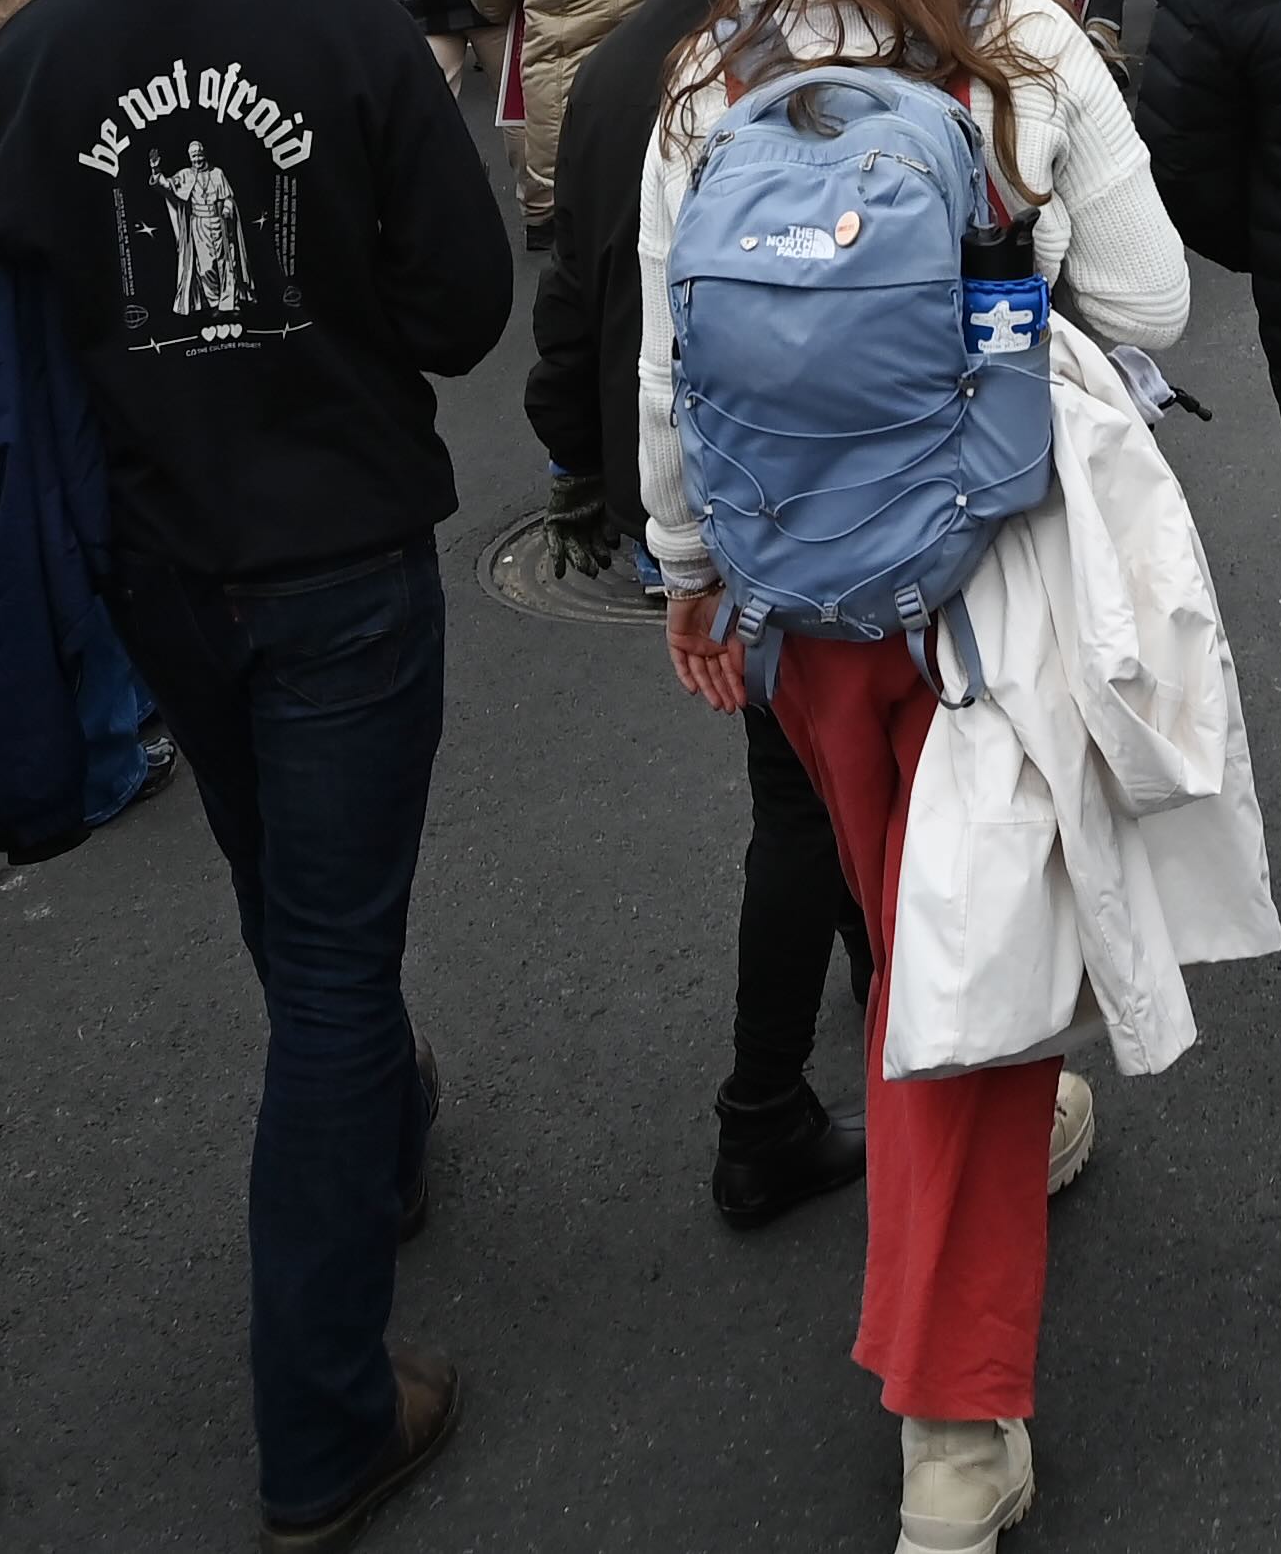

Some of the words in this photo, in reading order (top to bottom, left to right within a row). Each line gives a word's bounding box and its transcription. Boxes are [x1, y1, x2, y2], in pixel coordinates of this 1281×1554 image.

[78, 117, 131, 178] be
[118, 58, 191, 130] not
[198, 61, 313, 170] afraid
[787, 225, 815, 240] THE
[765, 235, 814, 250] NORTH
[775, 246, 812, 259] FACE
